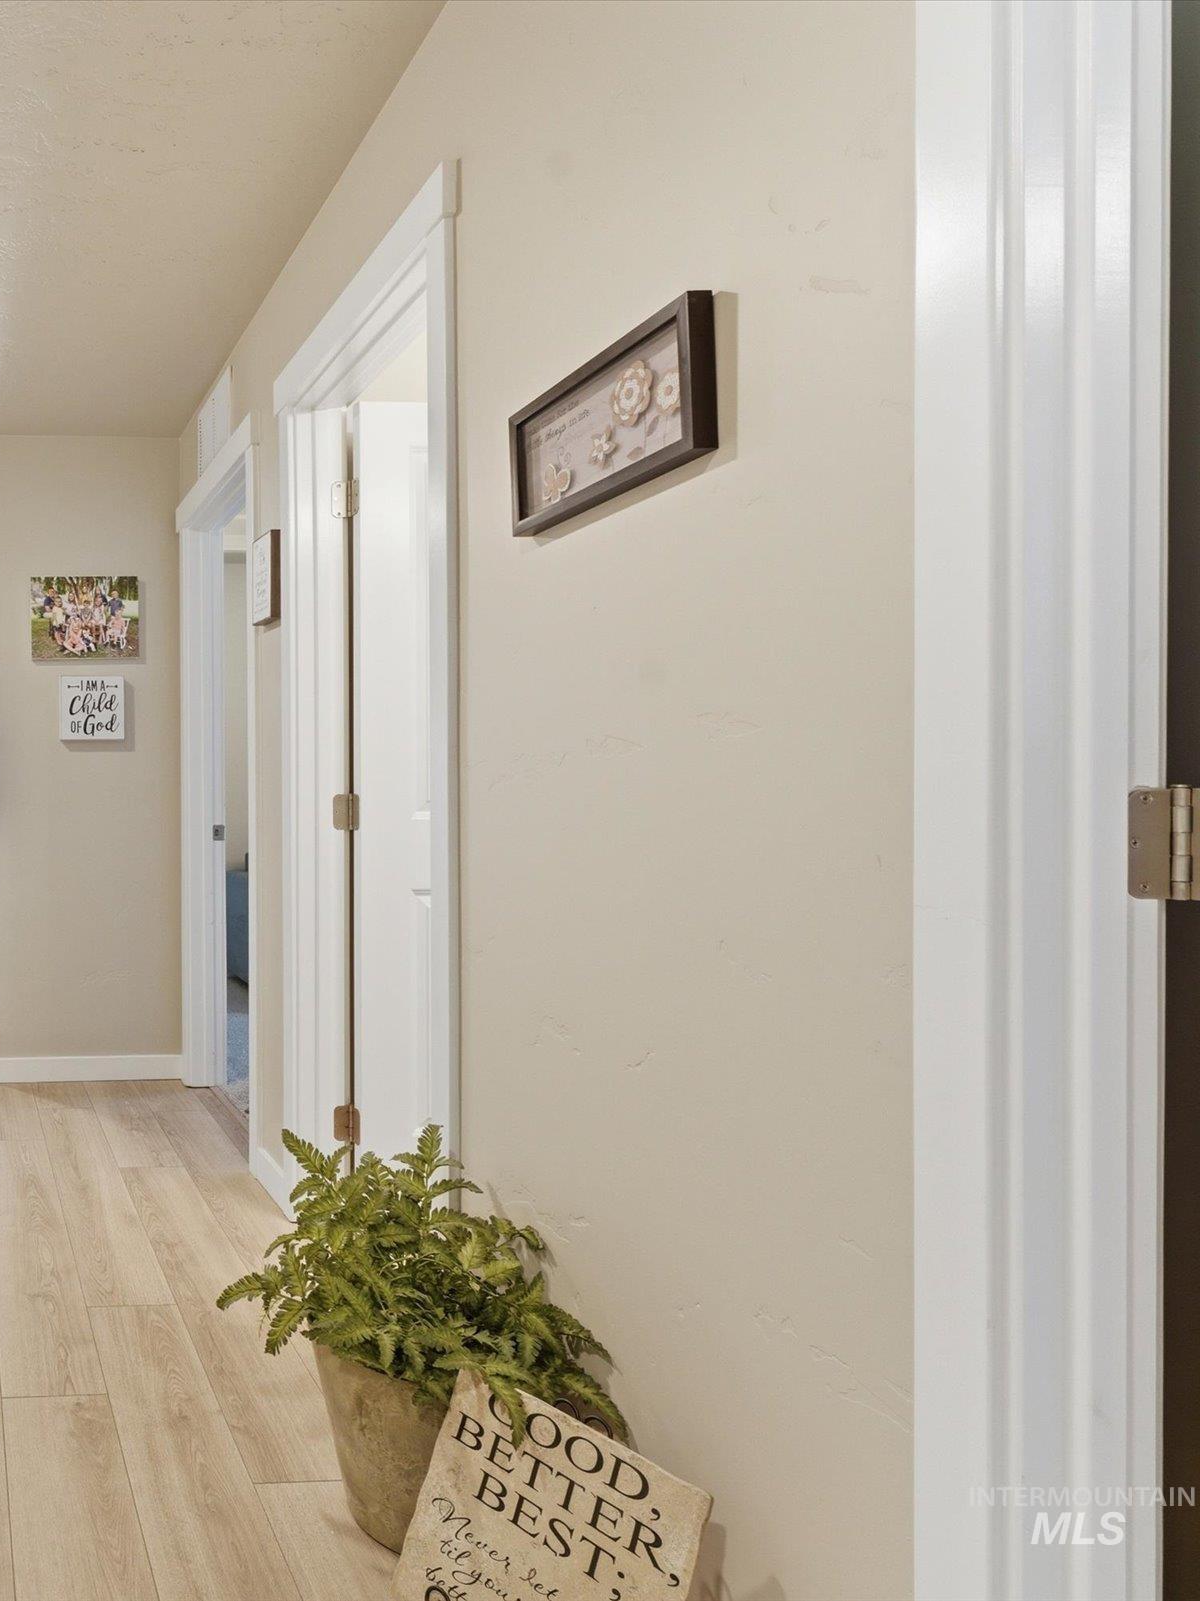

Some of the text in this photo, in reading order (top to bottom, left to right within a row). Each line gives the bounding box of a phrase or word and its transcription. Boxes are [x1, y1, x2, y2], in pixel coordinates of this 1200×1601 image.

[85, 680, 98, 692] AM
[100, 680, 106, 692] A
[69, 692, 119, 716] Child
[70, 714, 120, 737] OF God
[451, 1411, 680, 1587] BETTER,
[432, 1497, 559, 1600] Never let
[452, 1569, 520, 1601] you
